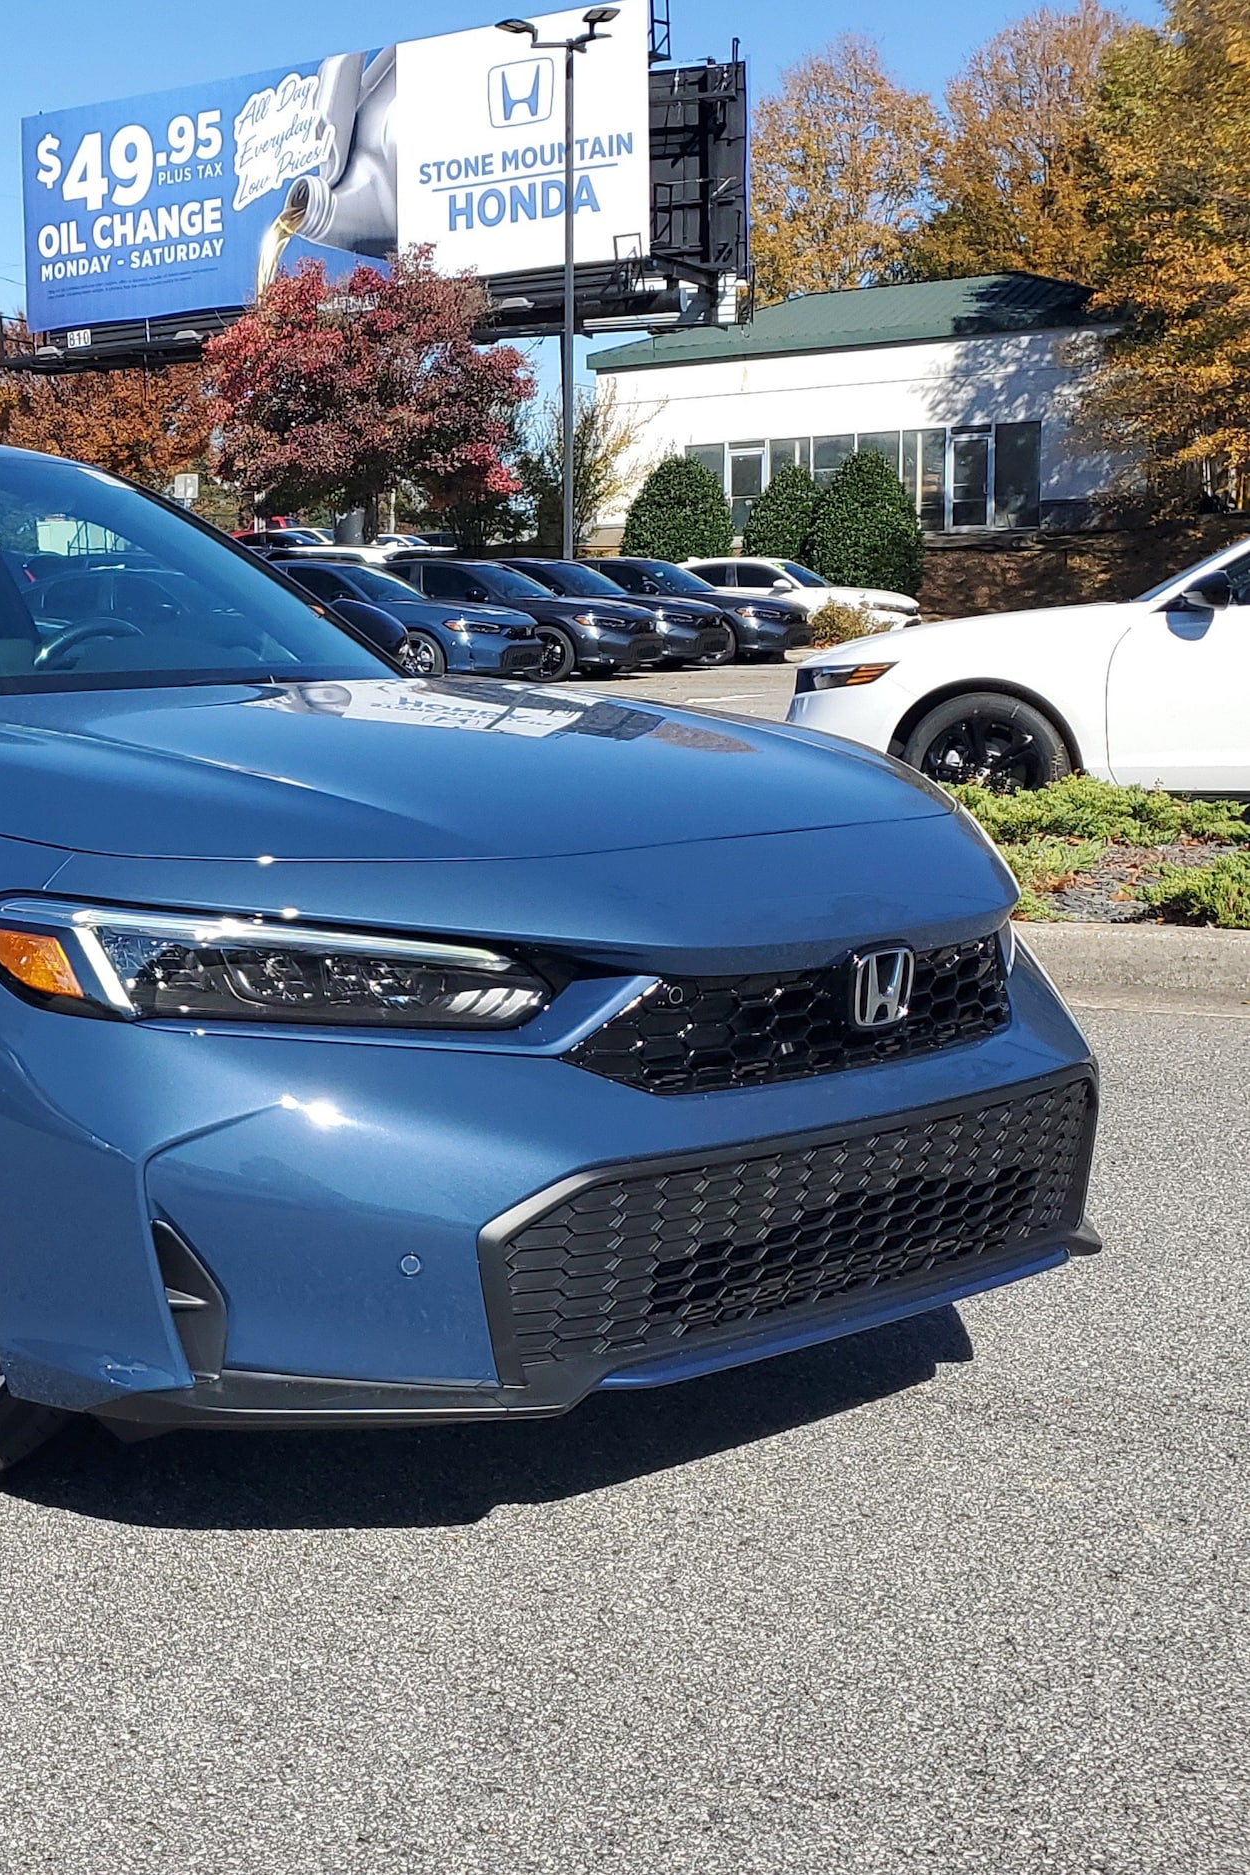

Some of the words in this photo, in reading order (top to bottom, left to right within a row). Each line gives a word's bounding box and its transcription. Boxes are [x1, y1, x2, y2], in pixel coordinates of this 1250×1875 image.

[238, 94, 271, 135] All
[276, 79, 314, 112] Day
[36, 109, 223, 211] $49.95
[238, 173, 271, 205] Low
[276, 130, 331, 183] Prices!
[239, 113, 316, 169] Everyday
[419, 153, 494, 184] STONE
[158, 167, 192, 186] PLUS
[196, 161, 223, 179] TAX
[37, 220, 87, 258] OIL
[92, 198, 223, 250] CHANGE
[448, 174, 601, 232] HONDA
[41, 254, 111, 282] MONDAY
[129, 238, 224, 269] SATURDAY
[68, 331, 90, 347] 810
